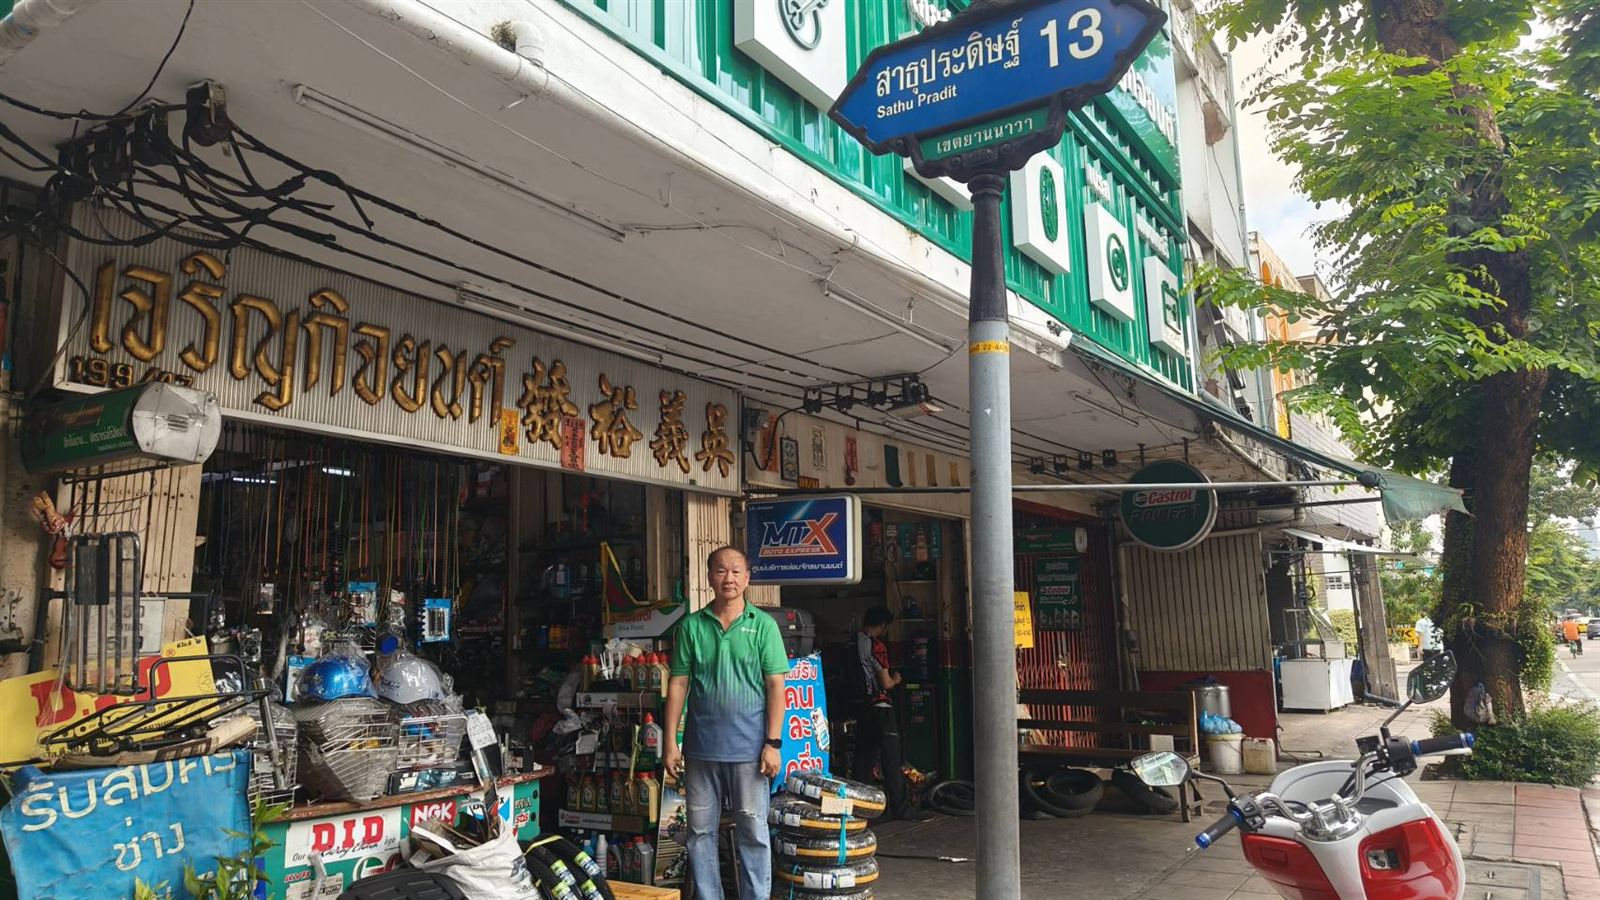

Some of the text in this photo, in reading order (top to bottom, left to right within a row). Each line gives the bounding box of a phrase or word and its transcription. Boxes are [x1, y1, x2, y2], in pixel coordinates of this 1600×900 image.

[876, 8, 1104, 97] สาธุประดิษฐ์ 13
[876, 85, 957, 119] Sathu Pradit
[937, 116, 1034, 153] เขตยานนาวา
[1148, 488, 1193, 505] Castrol
[784, 685, 815, 710] คน
[789, 714, 812, 740] ละ
[414, 801, 454, 824] NGK
[113, 817, 187, 872] ช่าง
[312, 815, 384, 851] DID
